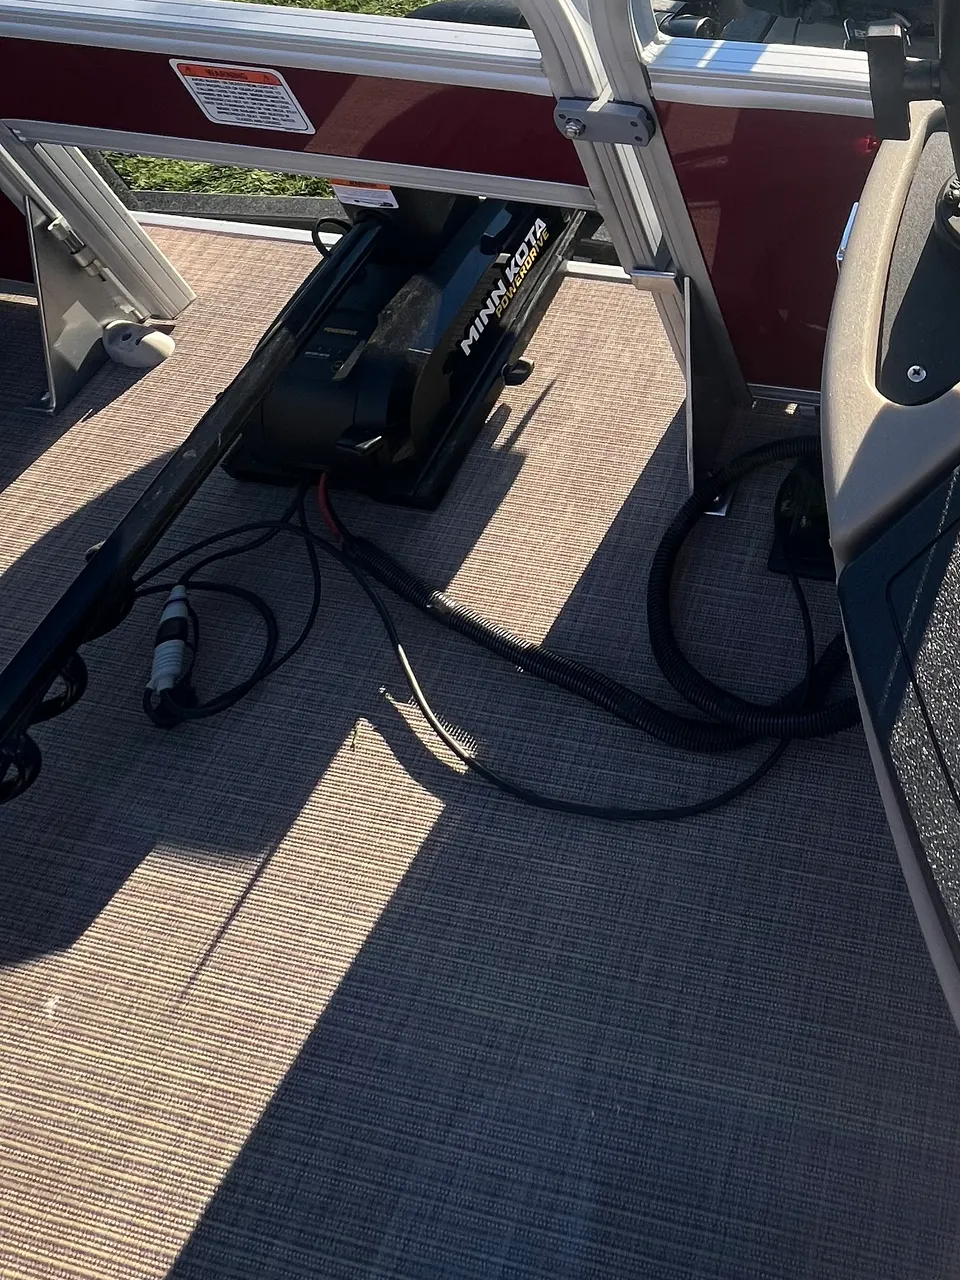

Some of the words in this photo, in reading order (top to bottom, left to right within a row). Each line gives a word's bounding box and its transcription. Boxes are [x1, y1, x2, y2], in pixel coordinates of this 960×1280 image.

[204, 68, 249, 80] WARNING
[460, 279, 507, 357] MINN
[505, 217, 547, 283] KOTA
[495, 227, 550, 319] POWERDRIVE
